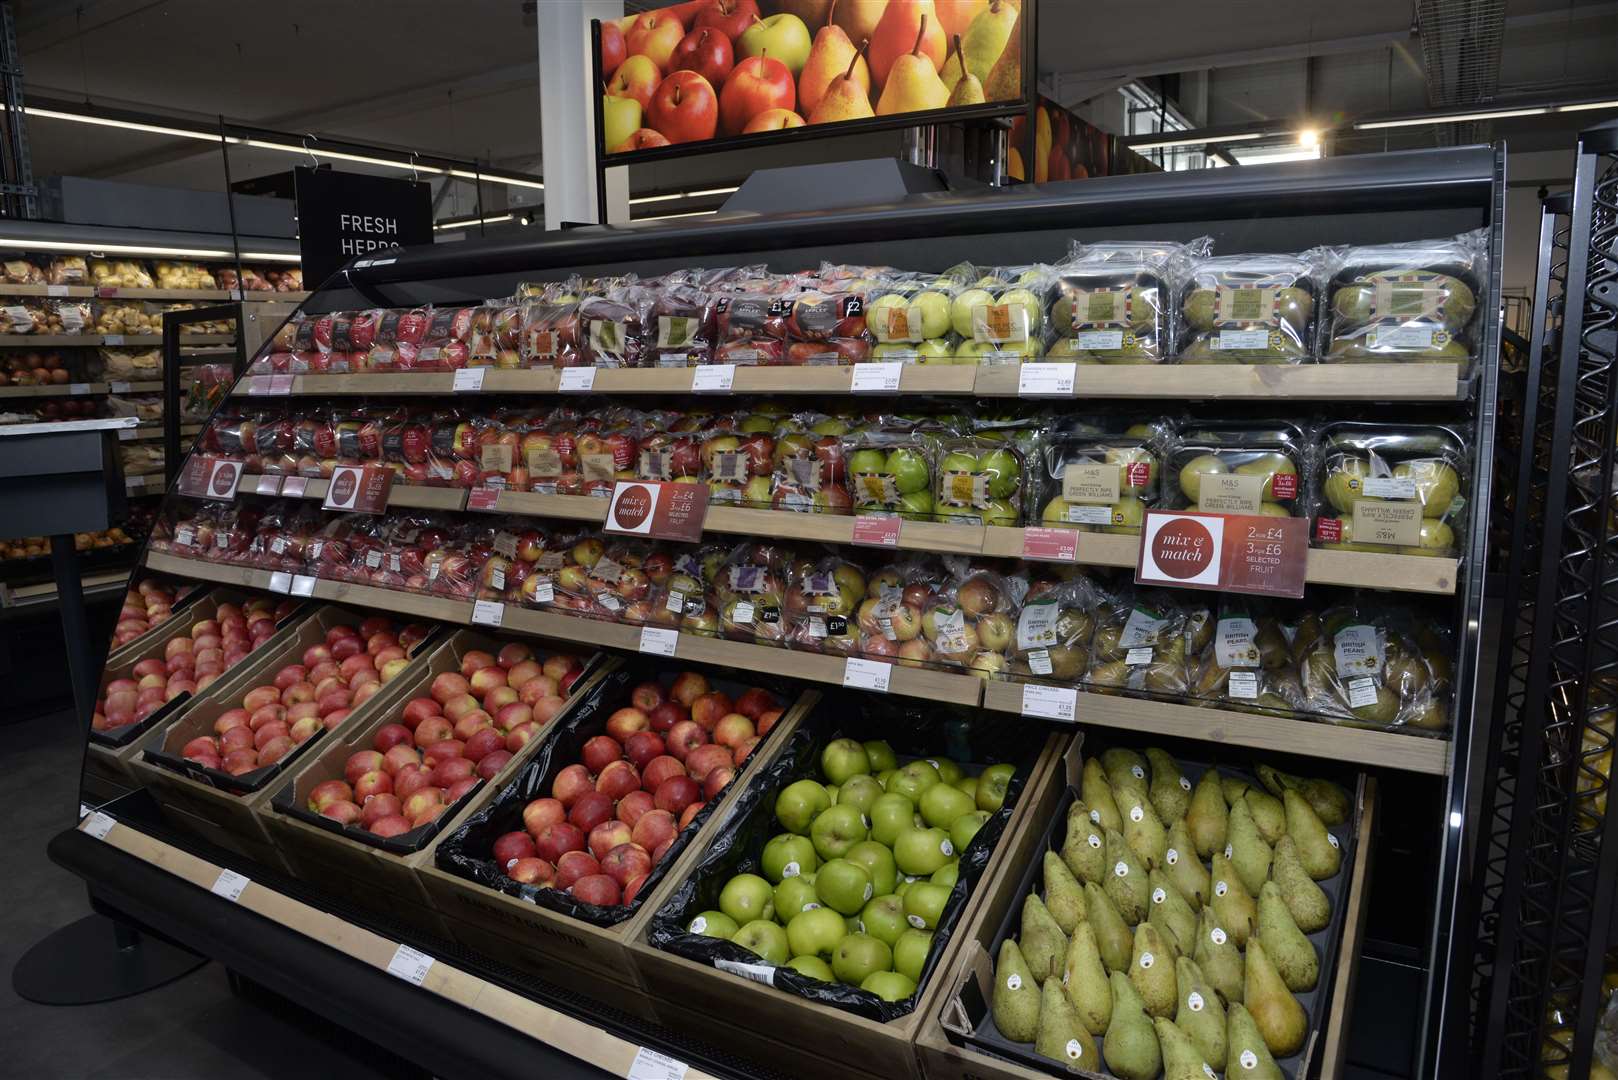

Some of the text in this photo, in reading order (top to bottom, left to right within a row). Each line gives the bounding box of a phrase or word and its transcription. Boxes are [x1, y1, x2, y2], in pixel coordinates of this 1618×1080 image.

[341, 214, 397, 234] FRESH
[1221, 479, 1239, 488] M&S
[621, 495, 639, 505] mix
[672, 490, 678, 499] 2
[684, 491, 695, 500] £4
[618, 506, 643, 516] match
[671, 502, 677, 510] 3
[681, 502, 692, 511] £6
[1248, 526, 1256, 538] 2
[1267, 527, 1282, 540] £4
[1376, 532, 1396, 540] M&S
[1163, 532, 1205, 548] mix &
[1246, 542, 1254, 554] 3
[1266, 543, 1281, 556] £6
[1160, 548, 1202, 562] match
[1246, 556, 1280, 565] SELECTED
[1250, 566, 1274, 574] FRUIT
